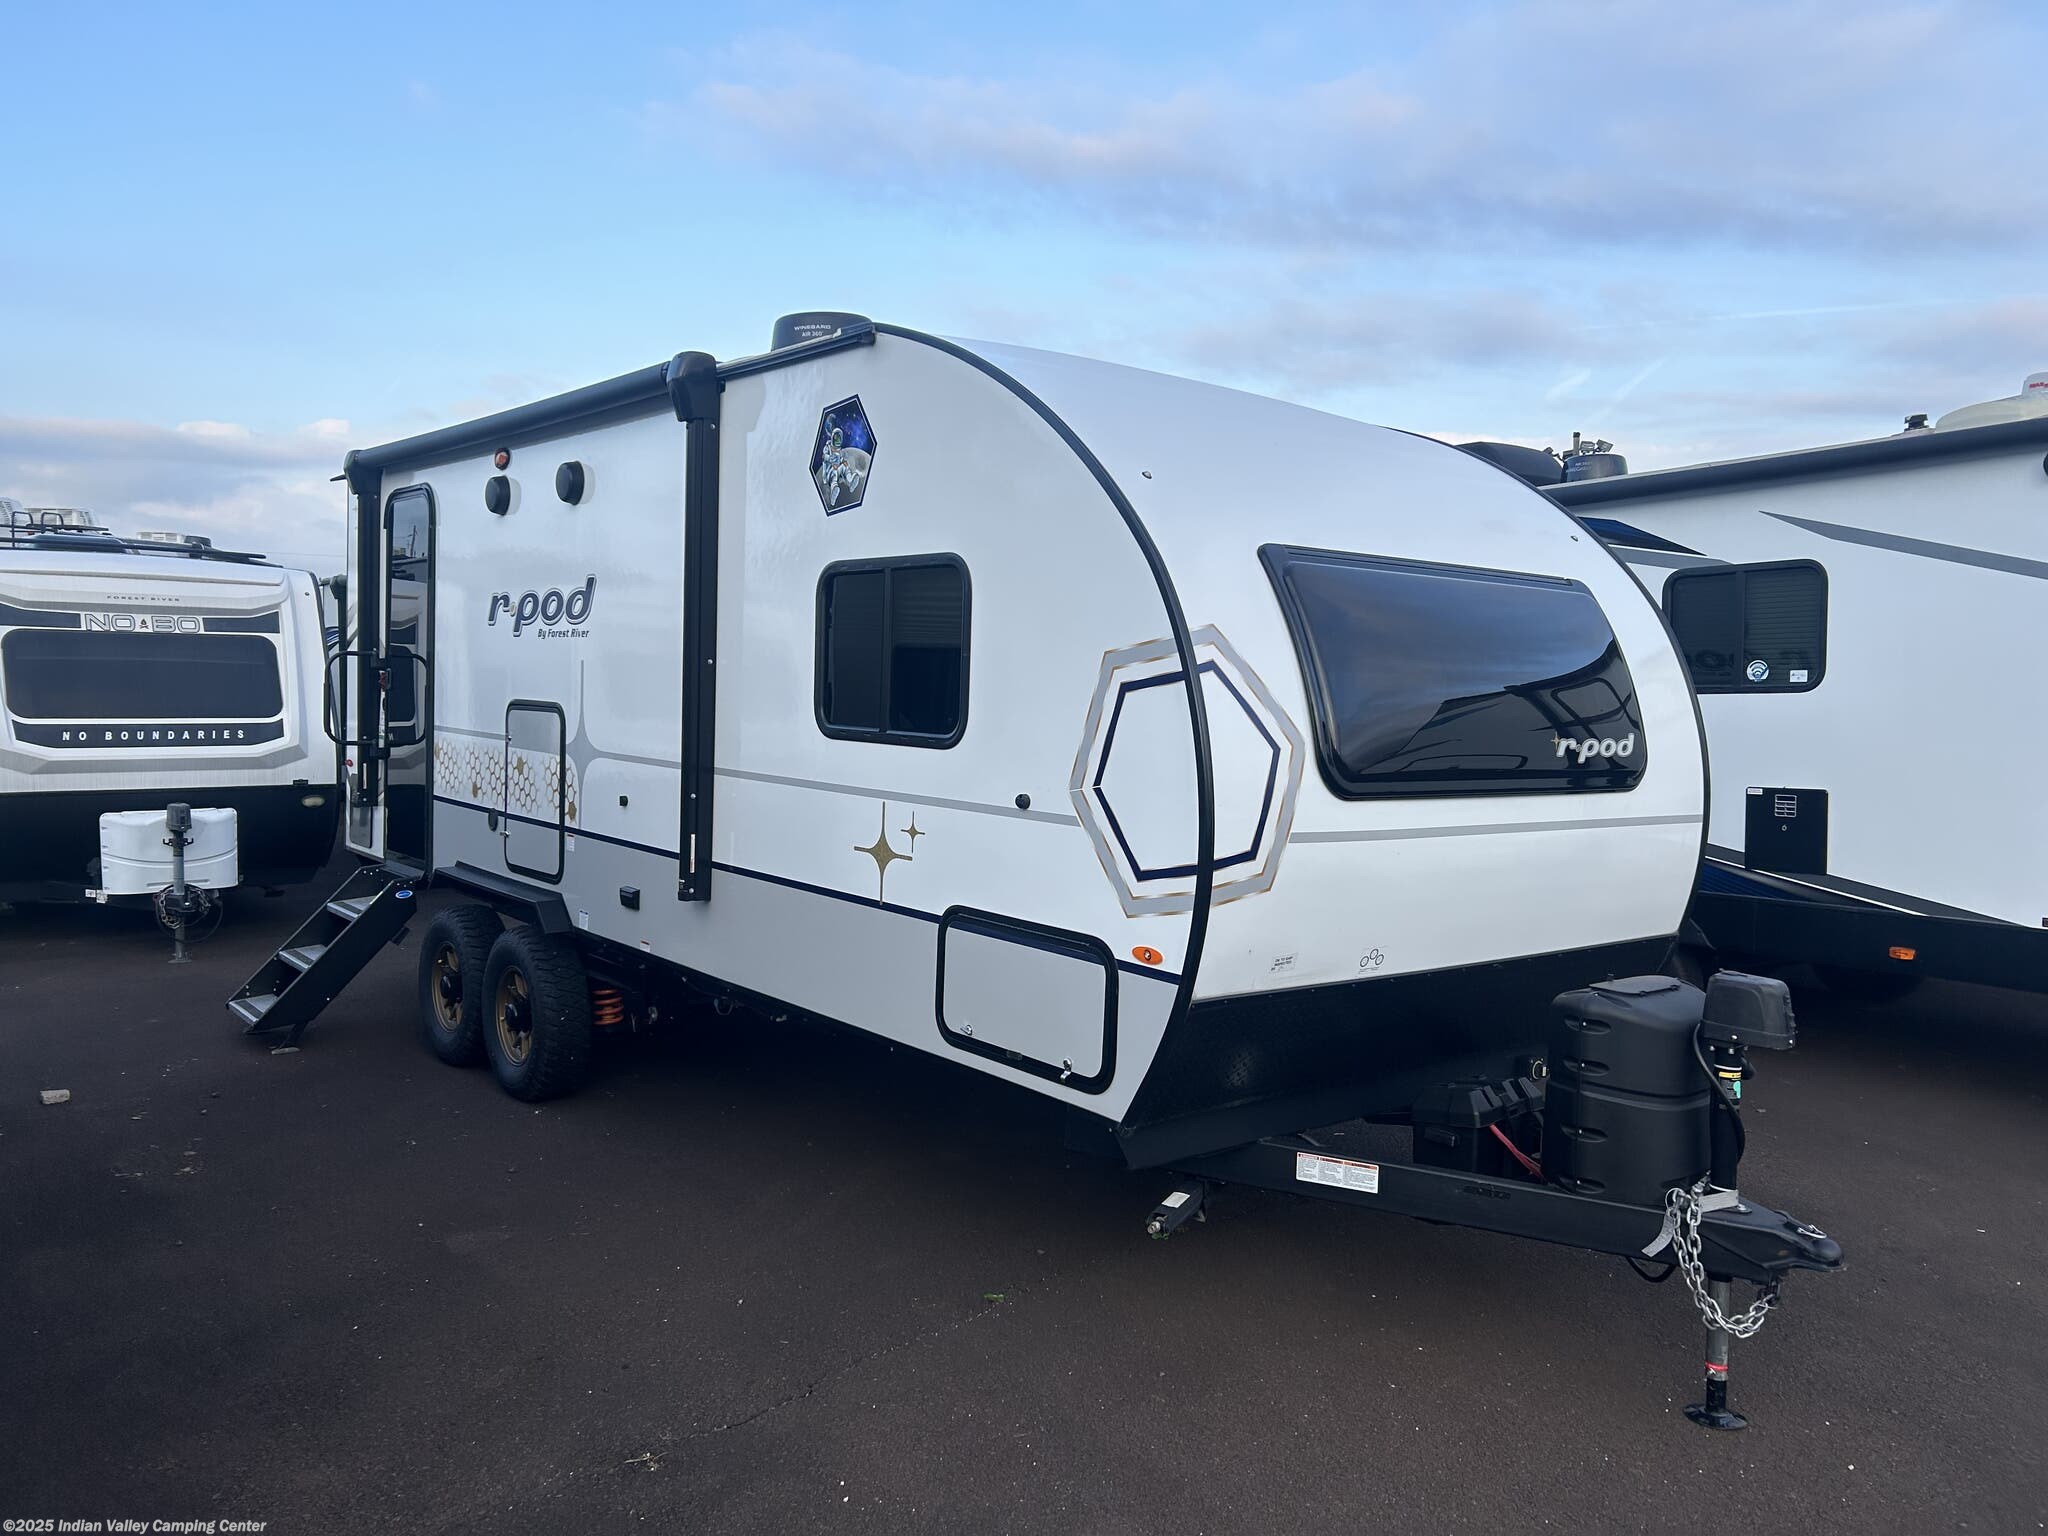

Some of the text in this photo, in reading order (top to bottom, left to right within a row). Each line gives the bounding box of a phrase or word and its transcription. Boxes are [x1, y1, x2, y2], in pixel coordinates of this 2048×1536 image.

[84, 613, 136, 632] NO
[538, 628, 590, 639] By Forest River
[62, 730, 245, 741] NO BOUNDARIES
